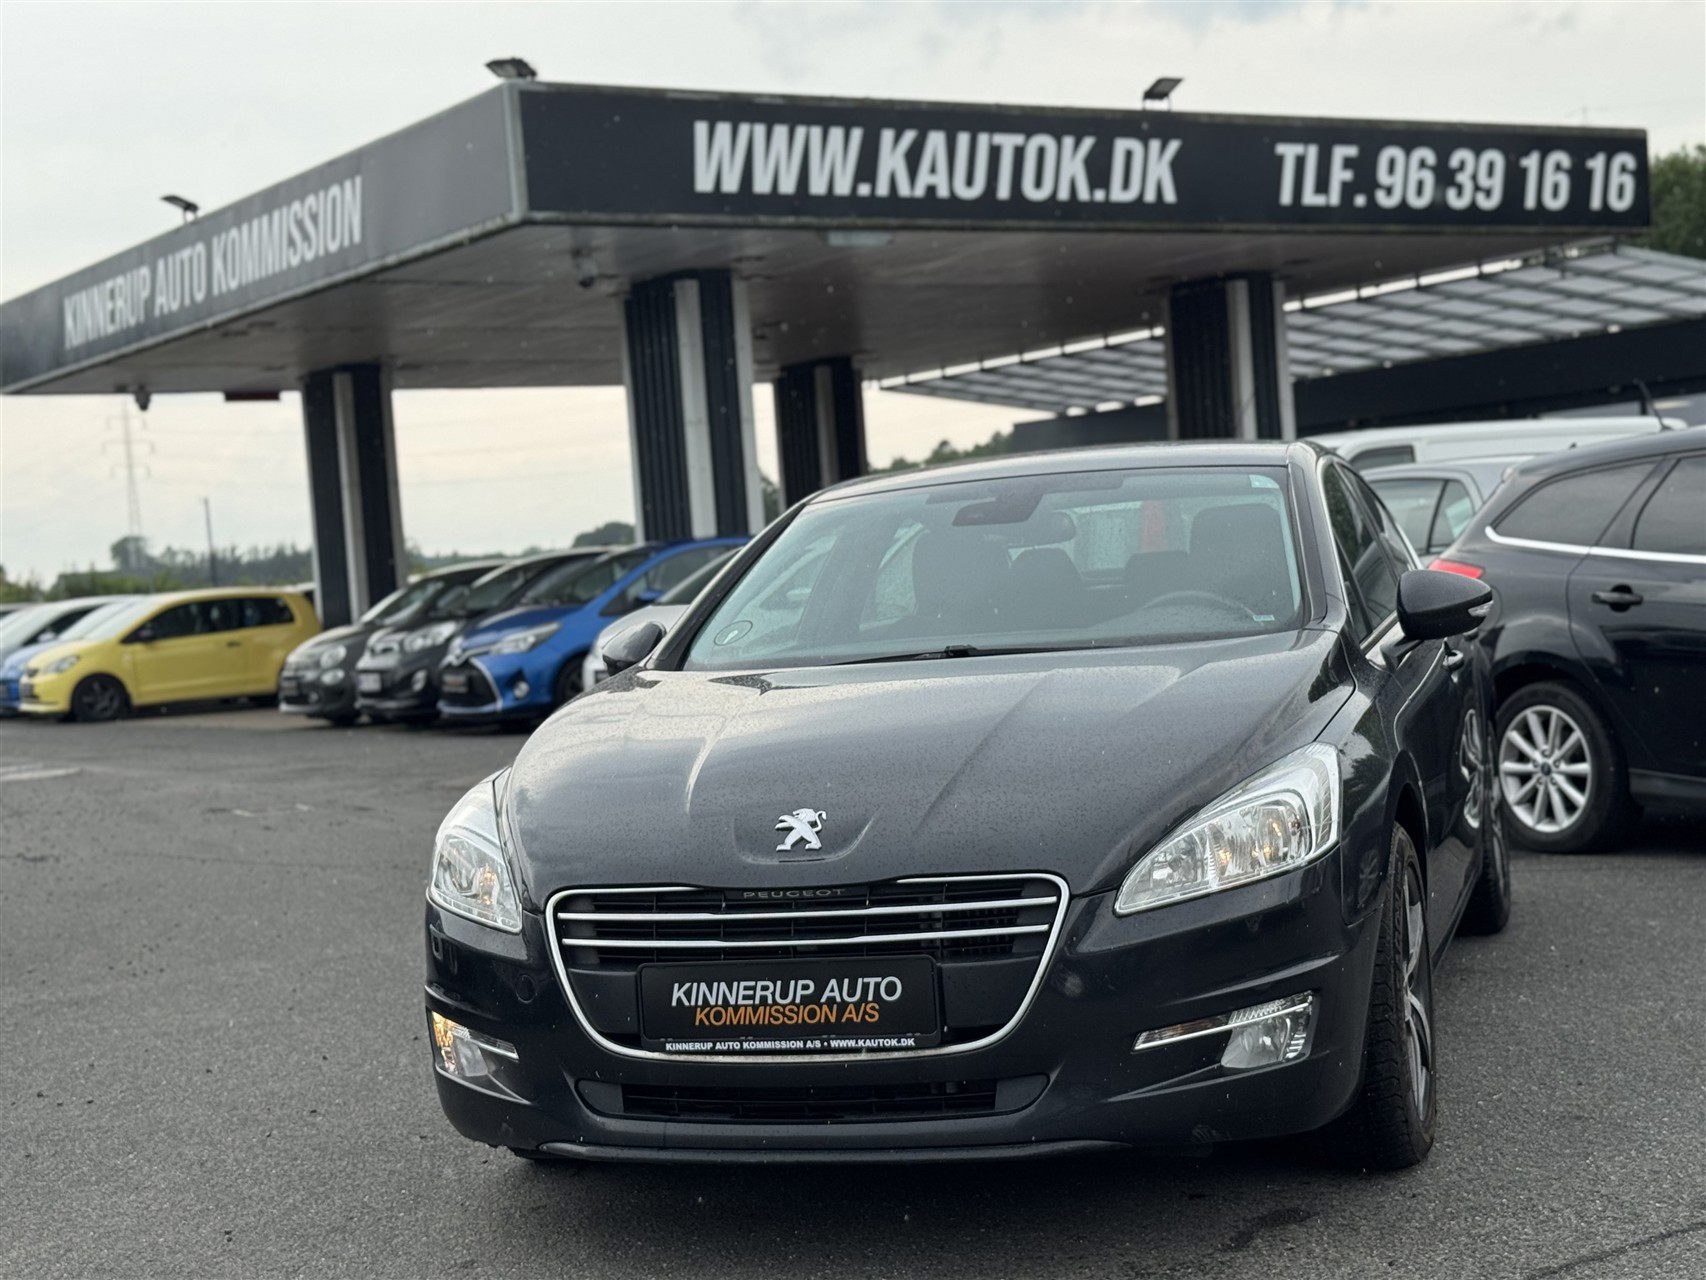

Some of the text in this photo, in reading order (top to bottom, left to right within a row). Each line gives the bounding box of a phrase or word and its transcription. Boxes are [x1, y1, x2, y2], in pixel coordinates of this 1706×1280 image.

[693, 120, 1183, 204] WWW.KAUTOK.DK
[1274, 142, 1637, 212] TLF. 96 39 16 16
[63, 175, 363, 350] KINNERUP AUTO KOMMISSION
[743, 888, 845, 899] PEUGEOT
[671, 976, 902, 1007] KINNERUP AUTO
[695, 1002, 880, 1026] KOMMISSION A/S
[665, 1038, 915, 1051] KINNERUP AUTO KOMMISSION A/S WWW.KAUTOK.DK
